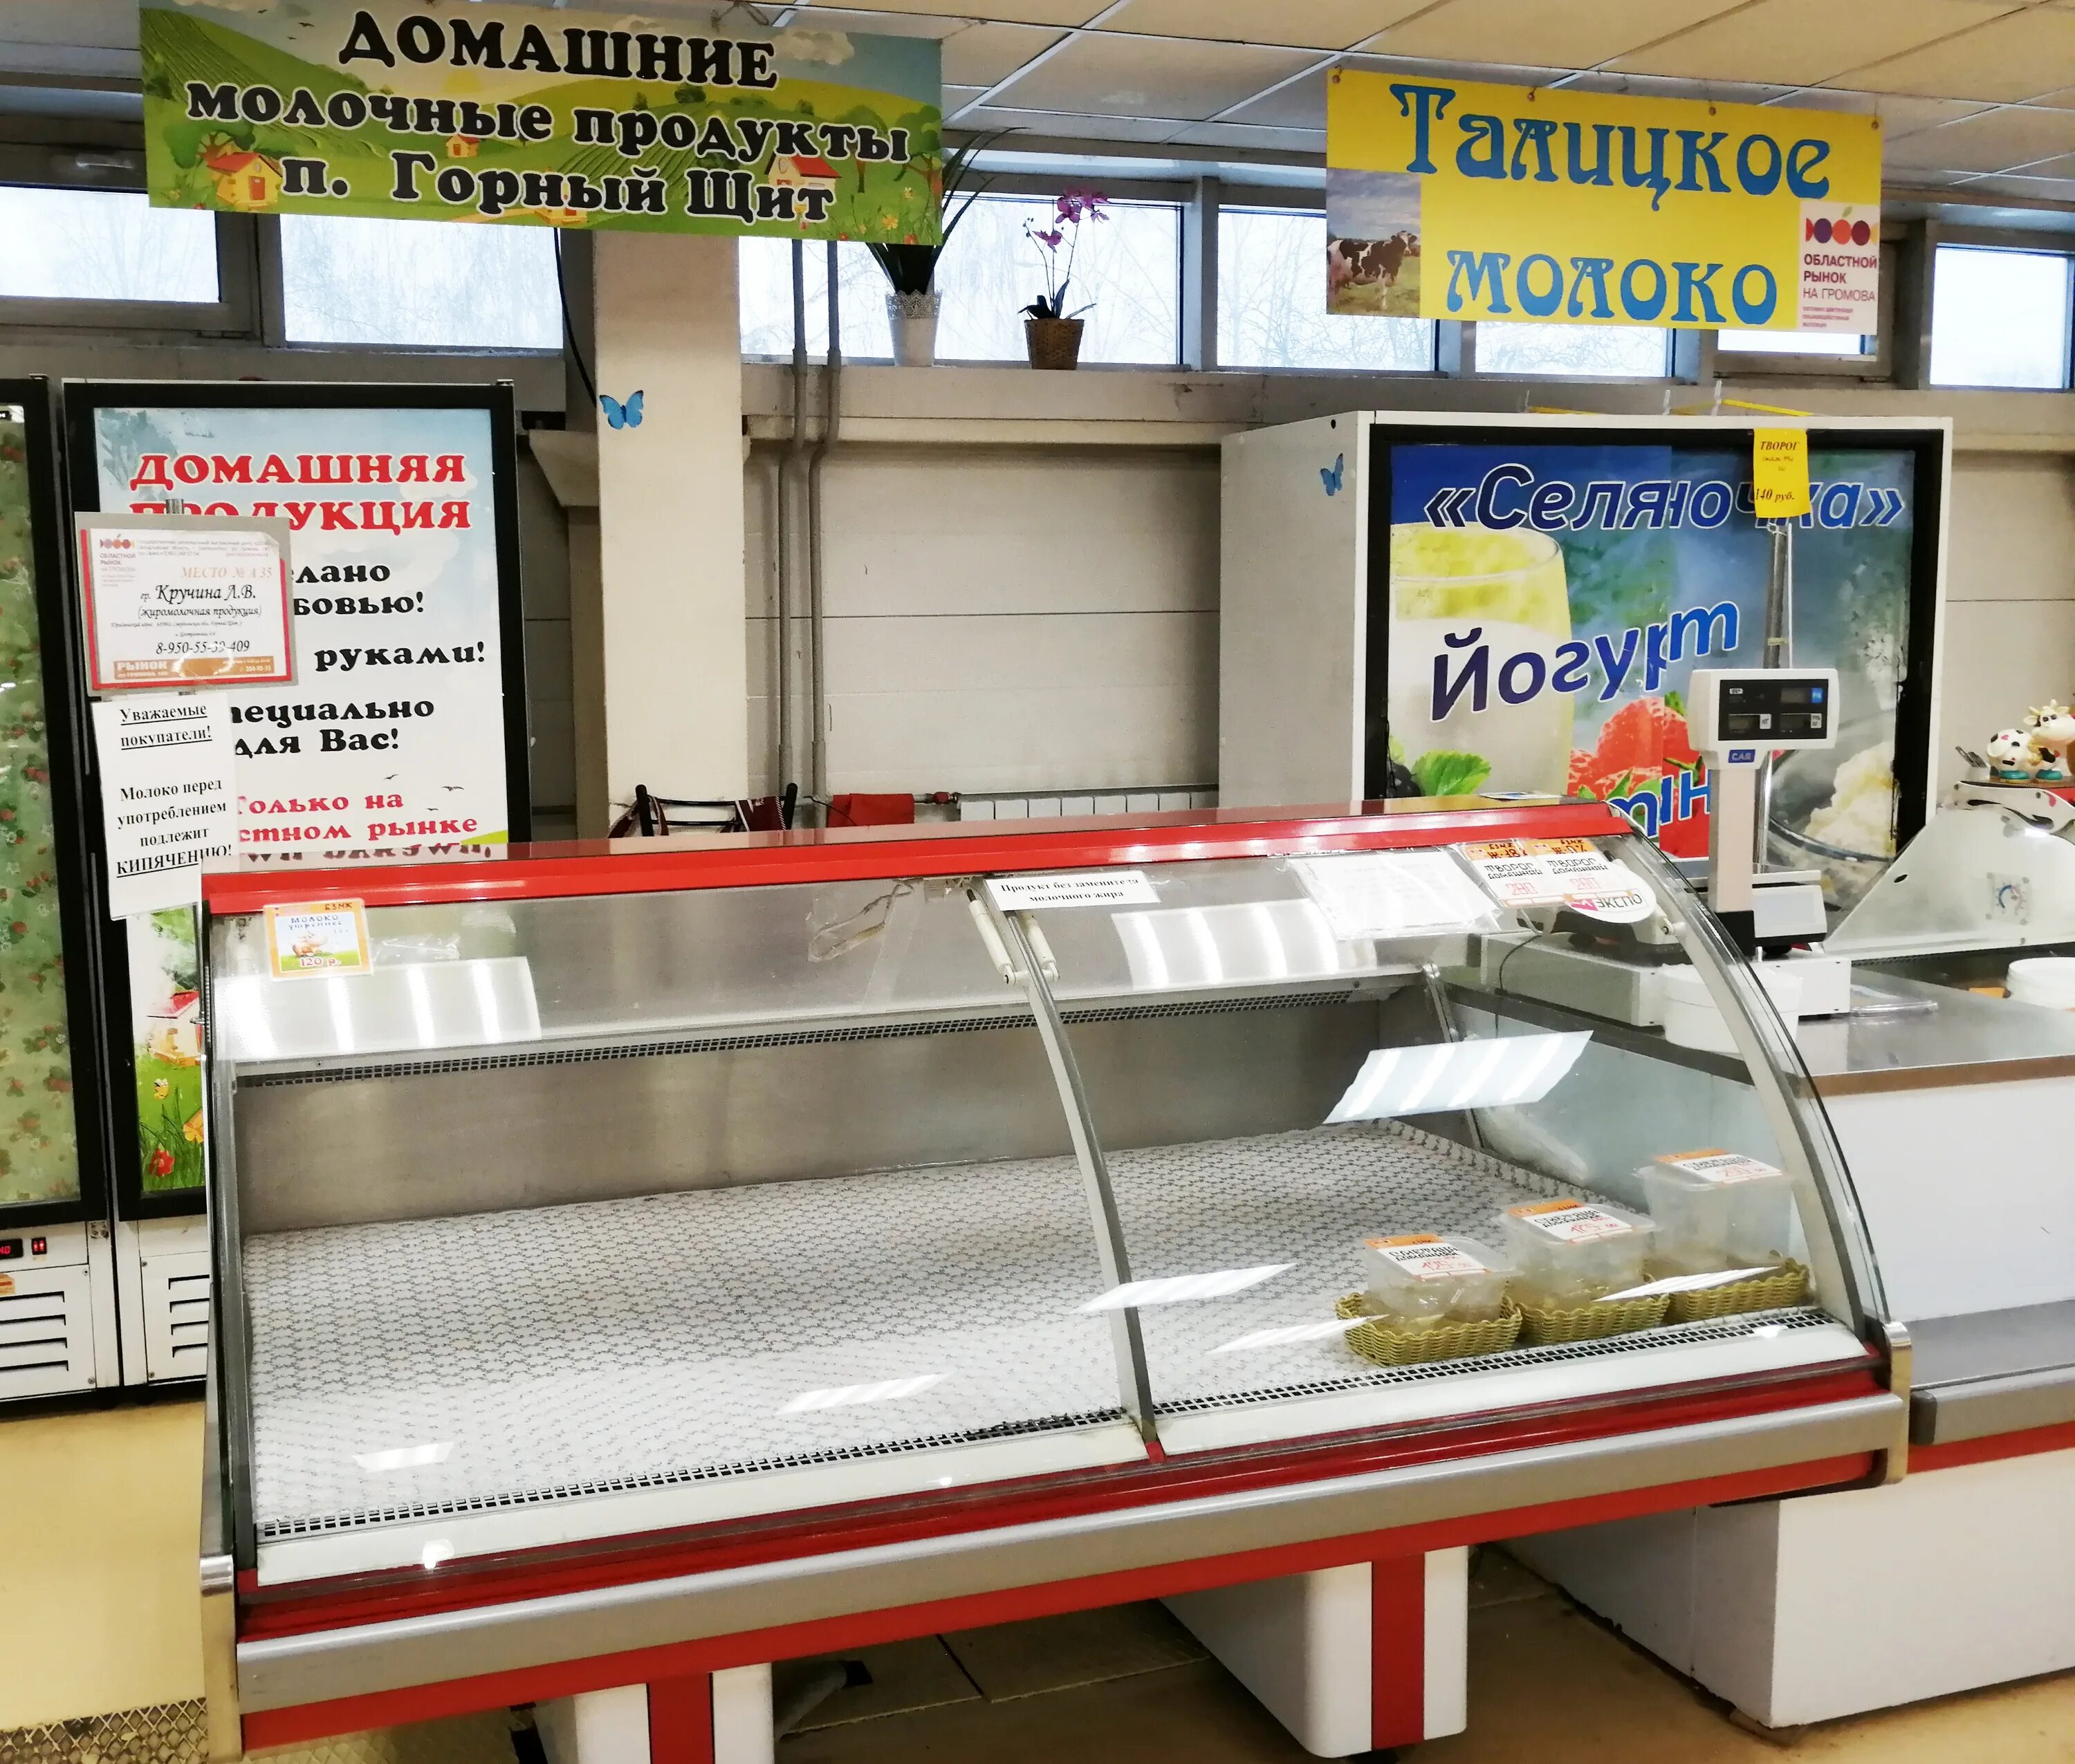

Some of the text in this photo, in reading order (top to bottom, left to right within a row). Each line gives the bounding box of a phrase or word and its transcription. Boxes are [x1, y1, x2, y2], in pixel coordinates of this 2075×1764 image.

[338, 10, 778, 89] ДОМАШНИЕ
[185, 81, 910, 165] молочные продукты
[1390, 83, 1830, 211] Талицкое
[281, 150, 835, 225] п. Горный Щит
[1804, 254, 1877, 268] ОБЛАСТНОЙ
[1804, 270, 1847, 284] РЫНОК
[1447, 250, 1778, 325] молоко
[1803, 288, 1875, 301] НА ГРОМОВА
[1760, 441, 1800, 451] ТВОРОГ
[130, 454, 466, 490] ДОМАШНЯЯ
[1774, 492, 1795, 503] руб.
[181, 567, 227, 578] МЕСТО
[156, 584, 221, 604] Кручина
[213, 604, 261, 618] продукция)
[314, 642, 486, 672] руками!
[1430, 601, 1740, 723] Йогурт
[119, 705, 207, 722] Уважаемые
[120, 725, 212, 748] покупатели!
[320, 728, 398, 753] Вас!
[120, 779, 222, 801] Молоко перед
[365, 794, 404, 810] на
[118, 802, 227, 830] употреблением
[140, 828, 209, 847] подлежит
[367, 818, 478, 841] рынке
[1001, 883, 1050, 893] Продукт
[1595, 893, 1643, 909] ЭКСПО
[301, 957, 322, 967] 120
